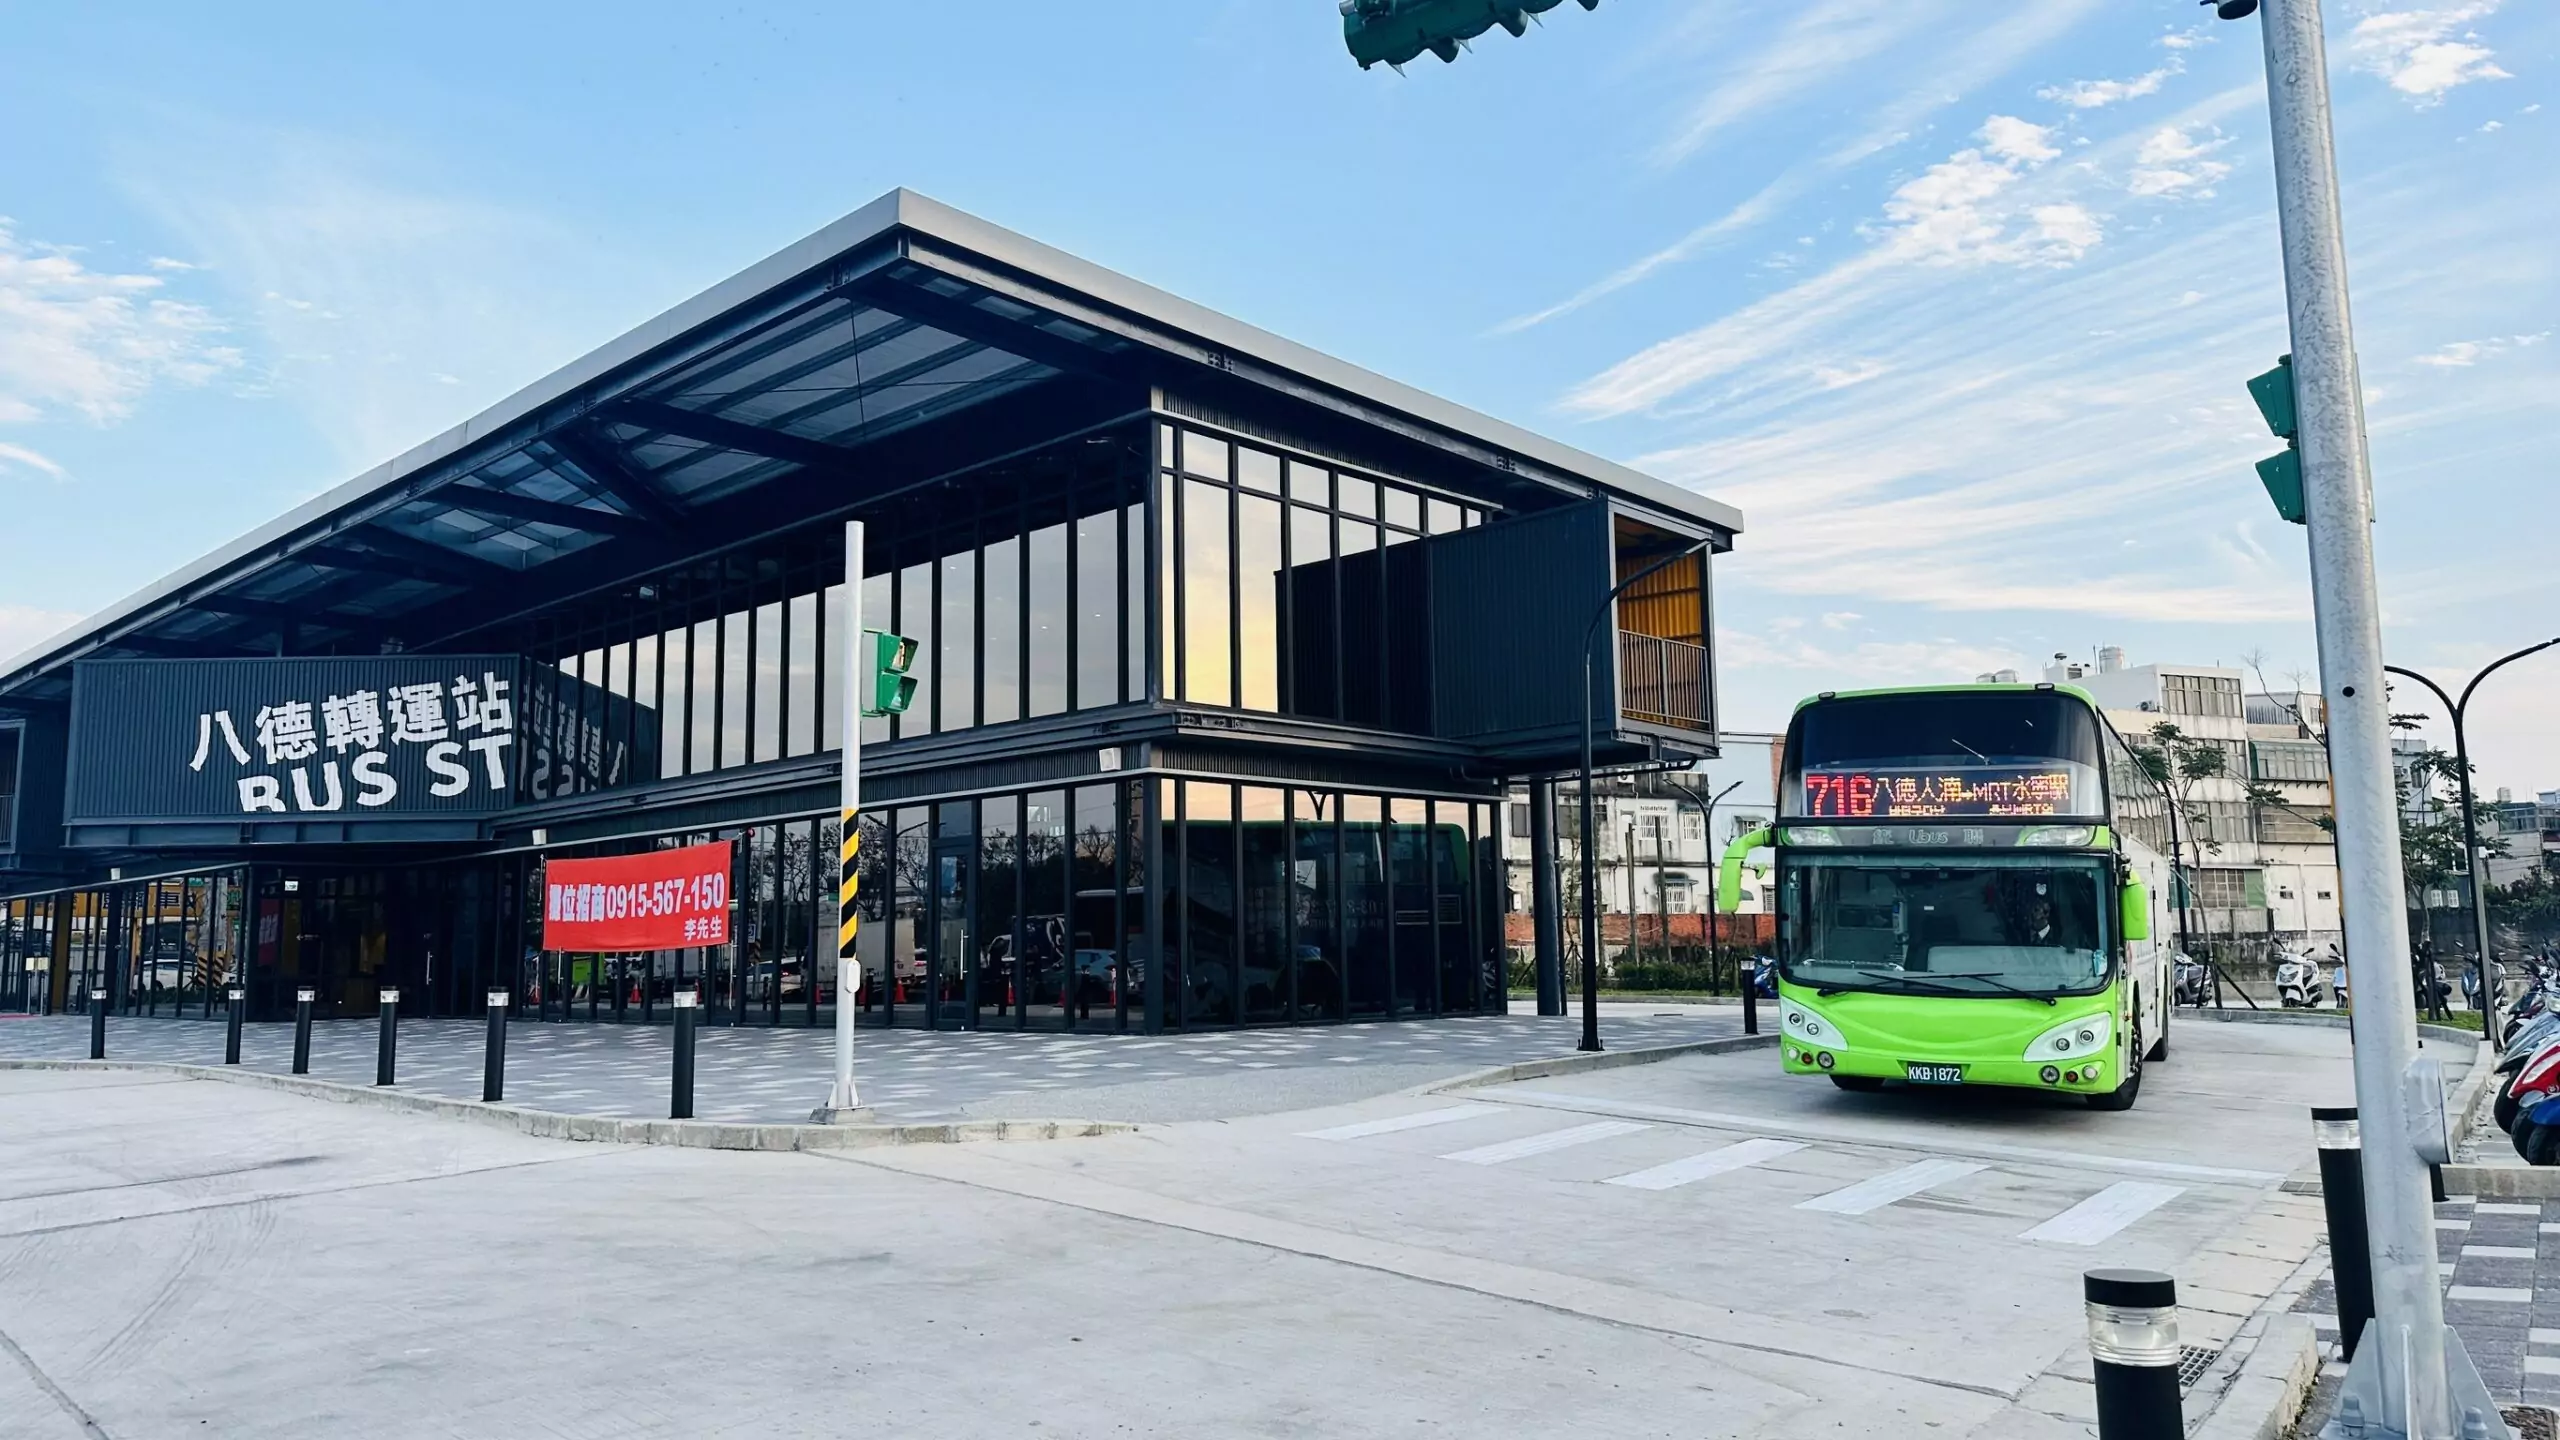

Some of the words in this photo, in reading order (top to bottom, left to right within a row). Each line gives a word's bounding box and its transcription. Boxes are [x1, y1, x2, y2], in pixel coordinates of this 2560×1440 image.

[189, 671, 513, 772] 八德轉運站
[425, 732, 513, 798] ST
[1806, 775, 1873, 816] 716
[684, 914, 723, 942] 李先生
[1908, 1066, 1961, 1081] KKB-1872
